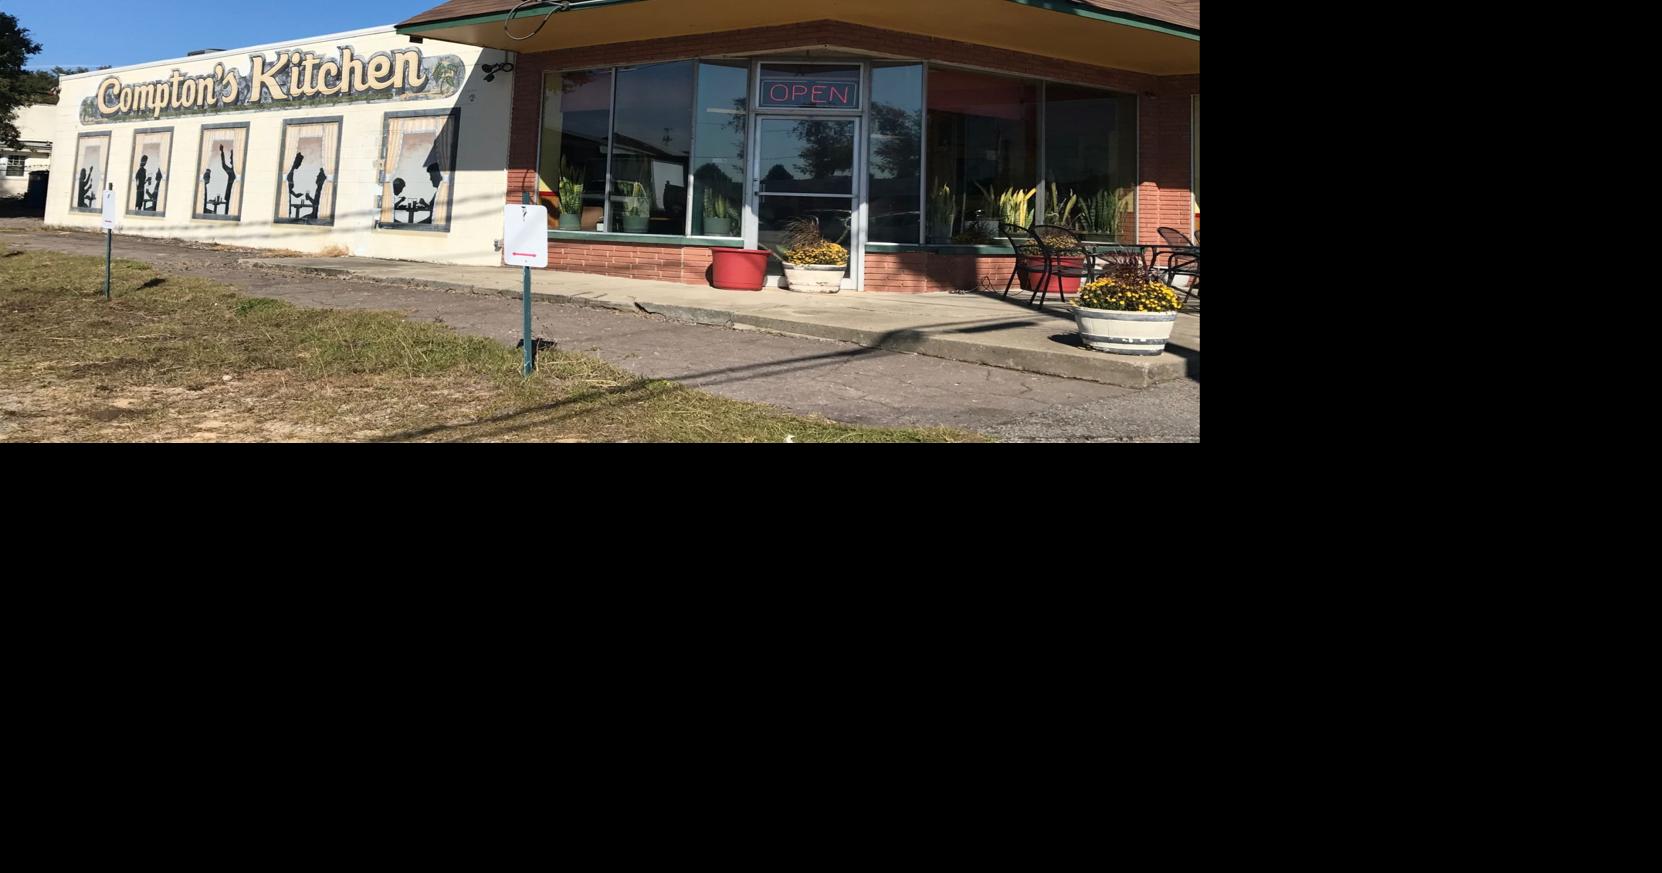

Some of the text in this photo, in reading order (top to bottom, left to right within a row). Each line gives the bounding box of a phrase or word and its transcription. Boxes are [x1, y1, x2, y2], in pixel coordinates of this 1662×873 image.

[96, 45, 424, 119] Compton's Kitchen
[769, 83, 849, 104] OPEN
